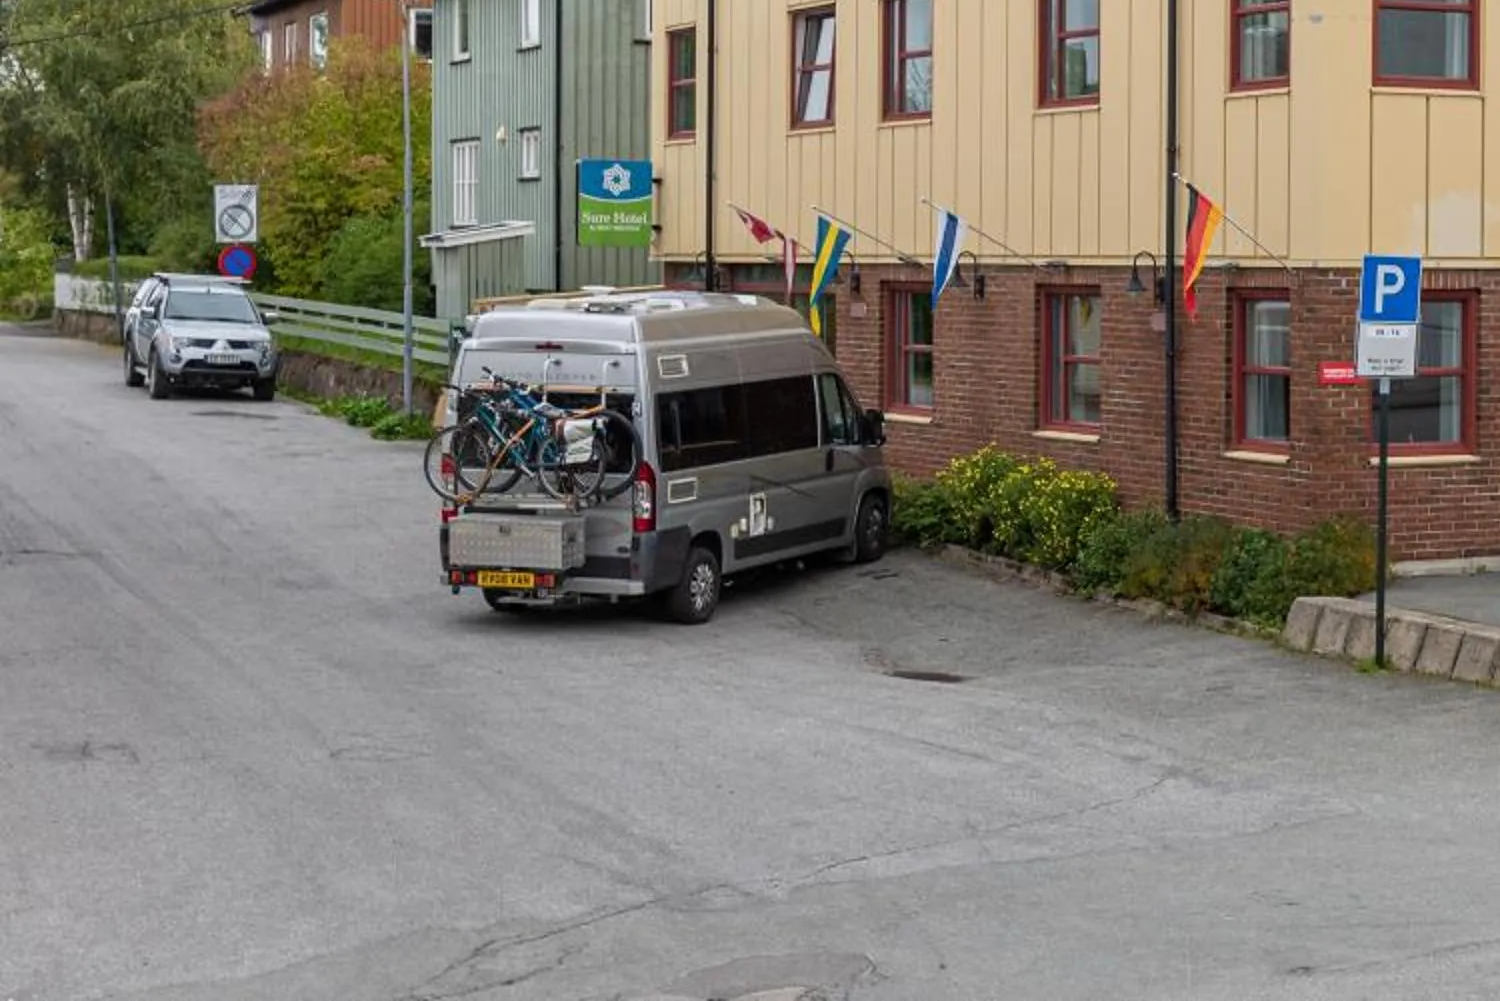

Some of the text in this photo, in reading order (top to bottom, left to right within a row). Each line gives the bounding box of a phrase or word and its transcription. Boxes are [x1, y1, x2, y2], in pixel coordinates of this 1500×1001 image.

[581, 210, 647, 224] Sure Hotel
[1374, 263, 1406, 314] P
